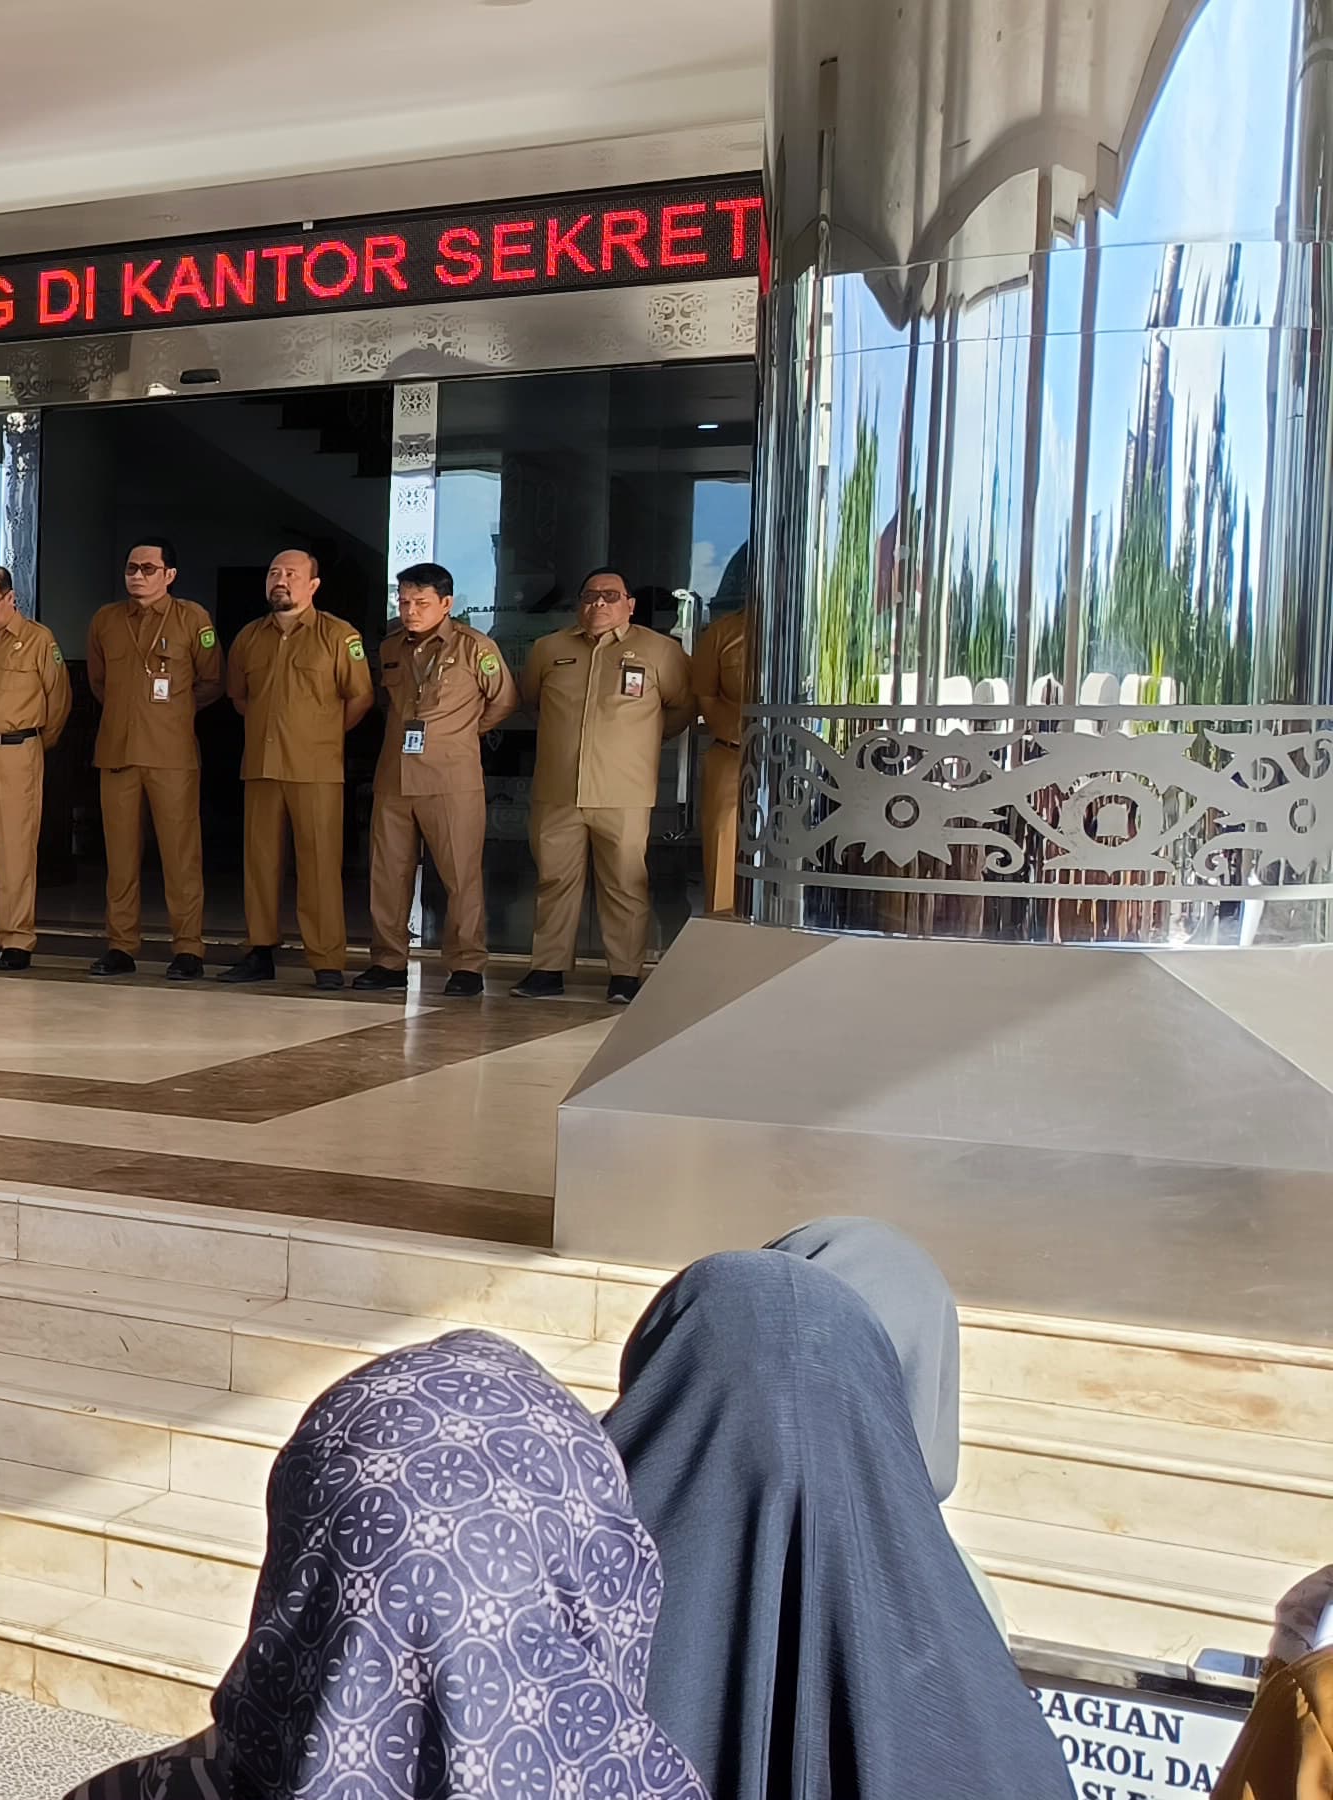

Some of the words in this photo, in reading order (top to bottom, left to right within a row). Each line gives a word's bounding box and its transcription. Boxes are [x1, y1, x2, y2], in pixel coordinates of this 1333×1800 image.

[39, 266, 96, 324] DI
[123, 235, 409, 316] KANTOR
[435, 197, 763, 286] SEKRET
[1164, 1756, 1222, 1793] DA
